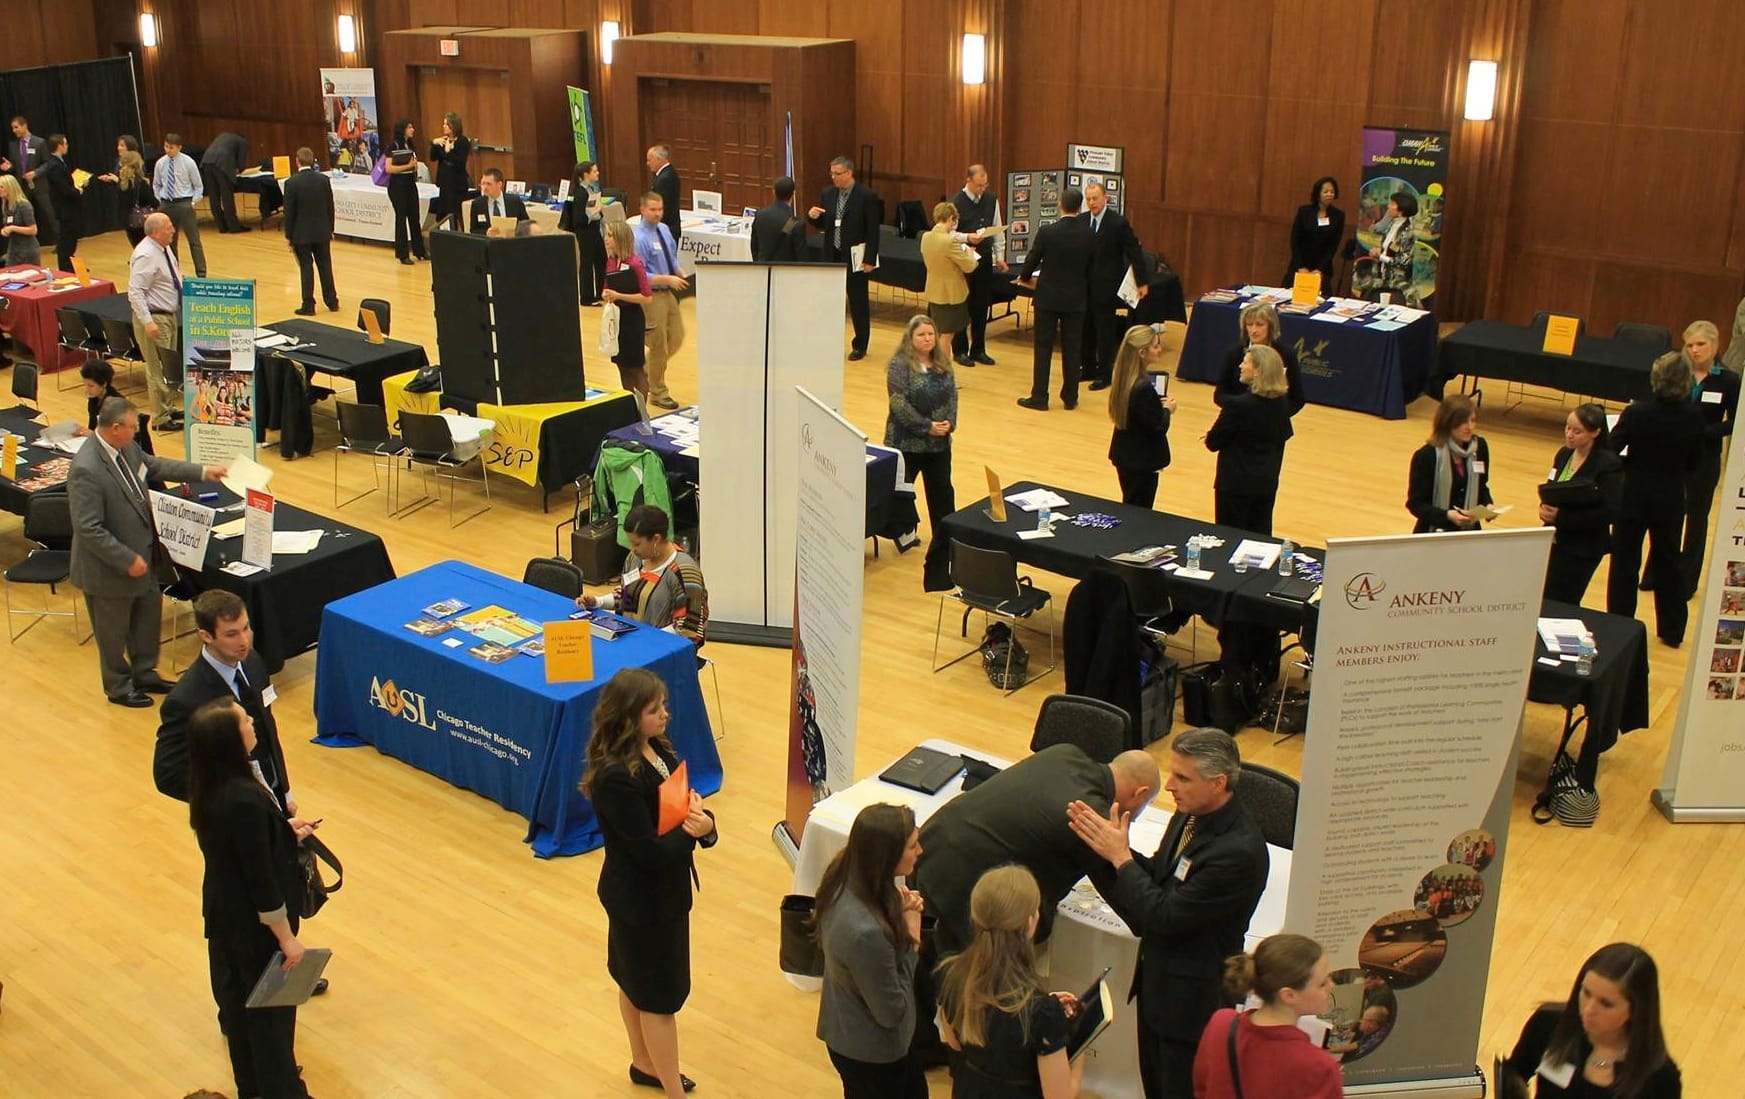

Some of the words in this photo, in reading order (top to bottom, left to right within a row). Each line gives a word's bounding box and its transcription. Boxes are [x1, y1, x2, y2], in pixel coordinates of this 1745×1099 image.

[1372, 154, 1399, 166] Building
[1400, 156, 1413, 165] The
[1414, 158, 1436, 168] Future
[681, 235, 721, 257] Expect
[189, 302, 217, 313] Teach
[219, 303, 251, 316] English
[190, 325, 200, 335] in
[203, 315, 226, 325] Public
[227, 316, 250, 326] School
[486, 441, 534, 469] SEP
[814, 450, 837, 477] ANKENY
[158, 497, 178, 516] Clinton
[178, 503, 212, 527] Community
[160, 521, 177, 541] School
[178, 527, 201, 549] District
[1390, 590, 1466, 609] ANKENY
[1387, 607, 1445, 618] COMMUNITY
[1447, 604, 1483, 615] SCHOOL
[1486, 602, 1527, 613] DISTRICT
[1337, 645, 1379, 655] ANKENY
[1383, 639, 1466, 652] INSTRUCTIONAL
[1468, 636, 1498, 647] STAFF
[1336, 656, 1384, 667] MEMBERS
[369, 675, 437, 731] AUSL
[436, 709, 464, 728] Chicago
[464, 720, 492, 739] Teacher
[493, 733, 532, 759] Residency
[450, 729, 520, 766] www.ausl-chicago.org
